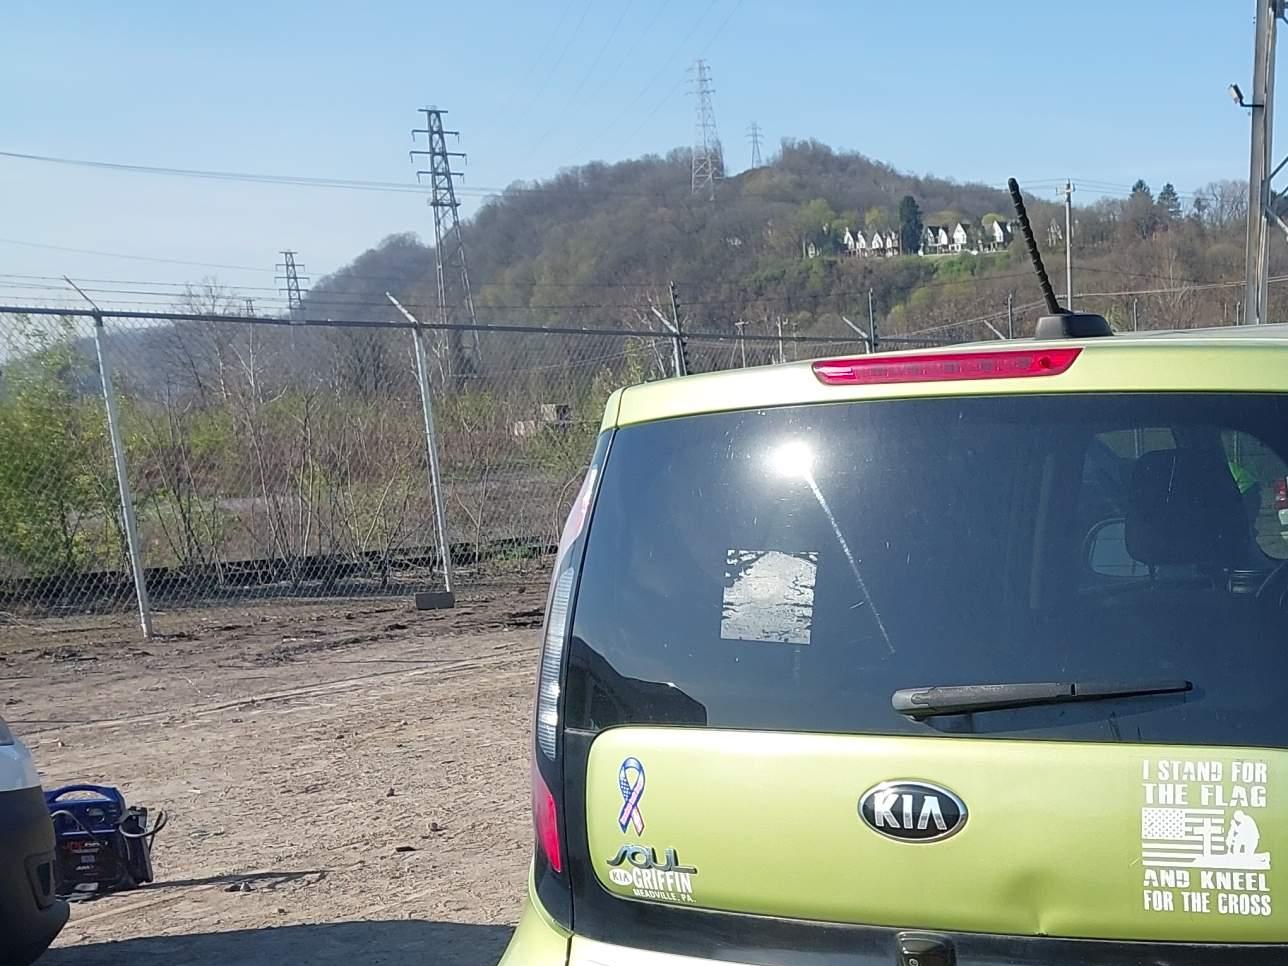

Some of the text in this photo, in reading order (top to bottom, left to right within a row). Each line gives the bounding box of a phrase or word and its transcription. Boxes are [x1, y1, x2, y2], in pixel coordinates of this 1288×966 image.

[1143, 760, 1268, 783] I STAND FOR
[1142, 784, 1267, 808] THE FLAG
[874, 791, 948, 830] KIA
[606, 845, 698, 875] SOUL
[612, 871, 630, 883] KIA
[632, 867, 693, 894] GRIFFIN
[1143, 868, 1271, 892] AND KNEEL
[1143, 890, 1272, 916] FOR THE CROSS
